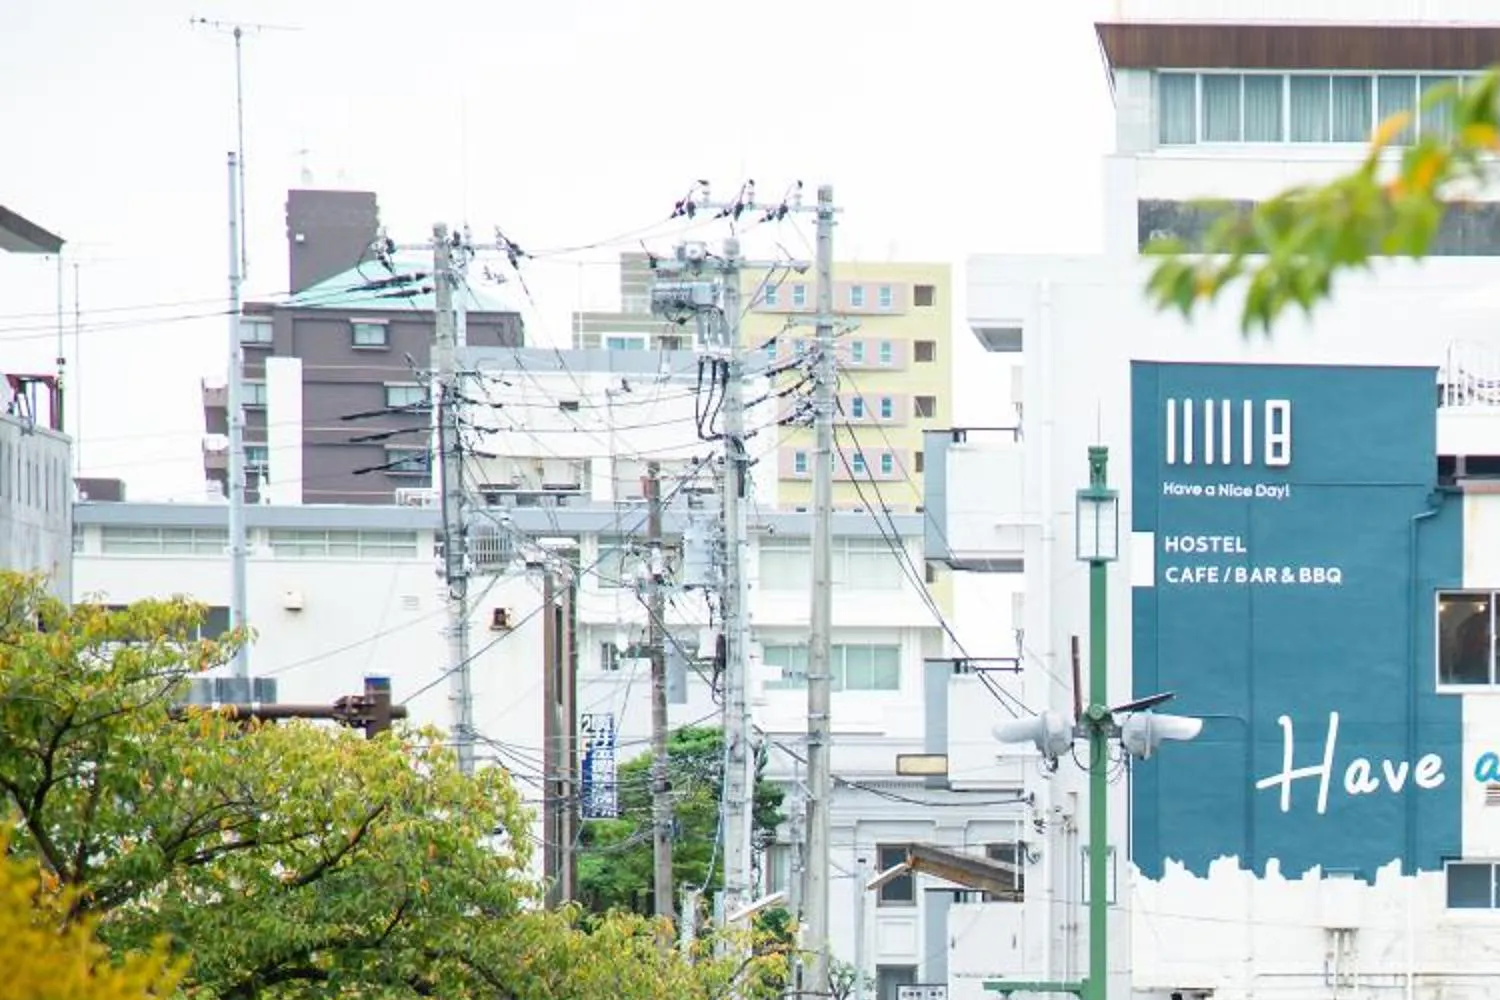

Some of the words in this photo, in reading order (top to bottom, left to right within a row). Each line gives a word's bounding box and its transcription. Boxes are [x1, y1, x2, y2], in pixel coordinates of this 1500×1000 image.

[1163, 481, 1202, 496] Have
[1205, 485, 1216, 497] a
[1218, 483, 1253, 497] Nice
[1255, 483, 1290, 501] Day!
[1165, 535, 1247, 553] HOSTEL
[1165, 566, 1219, 583] CAFE
[1299, 566, 1342, 584] BBQ
[1256, 711, 1446, 815] Have
